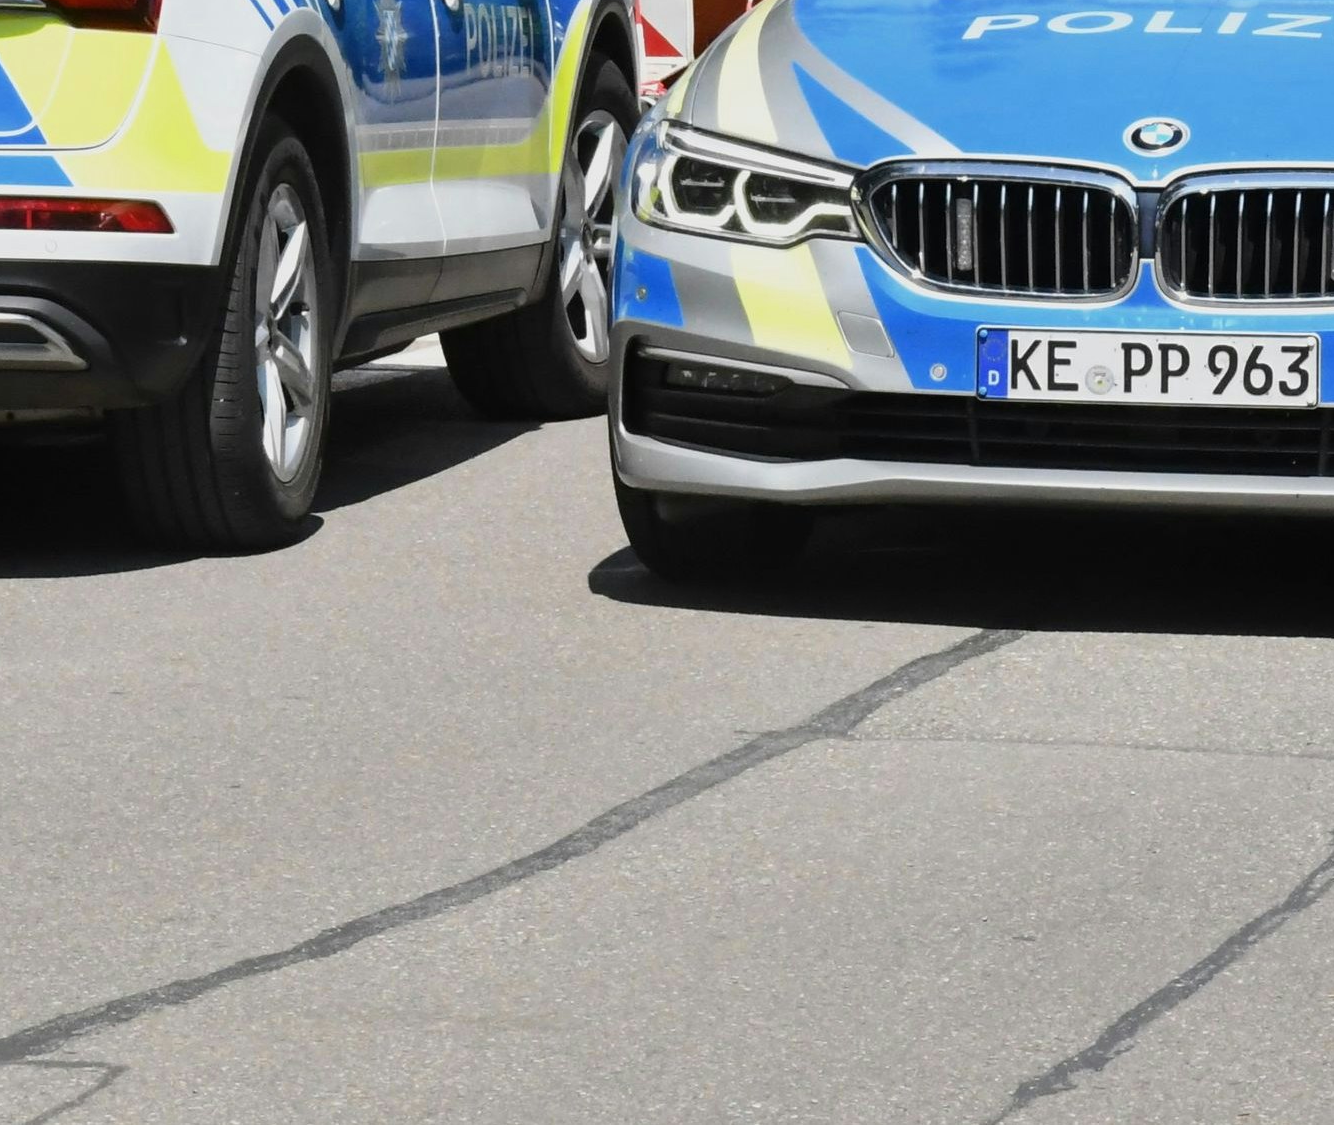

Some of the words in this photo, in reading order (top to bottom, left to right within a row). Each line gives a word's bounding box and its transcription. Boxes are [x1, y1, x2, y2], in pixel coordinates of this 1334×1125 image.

[463, 2, 535, 79] POLIZEI
[988, 369, 1000, 386] D
[1010, 339, 1079, 392] KE
[1121, 342, 1190, 394] PP
[1208, 344, 1310, 397] 963
